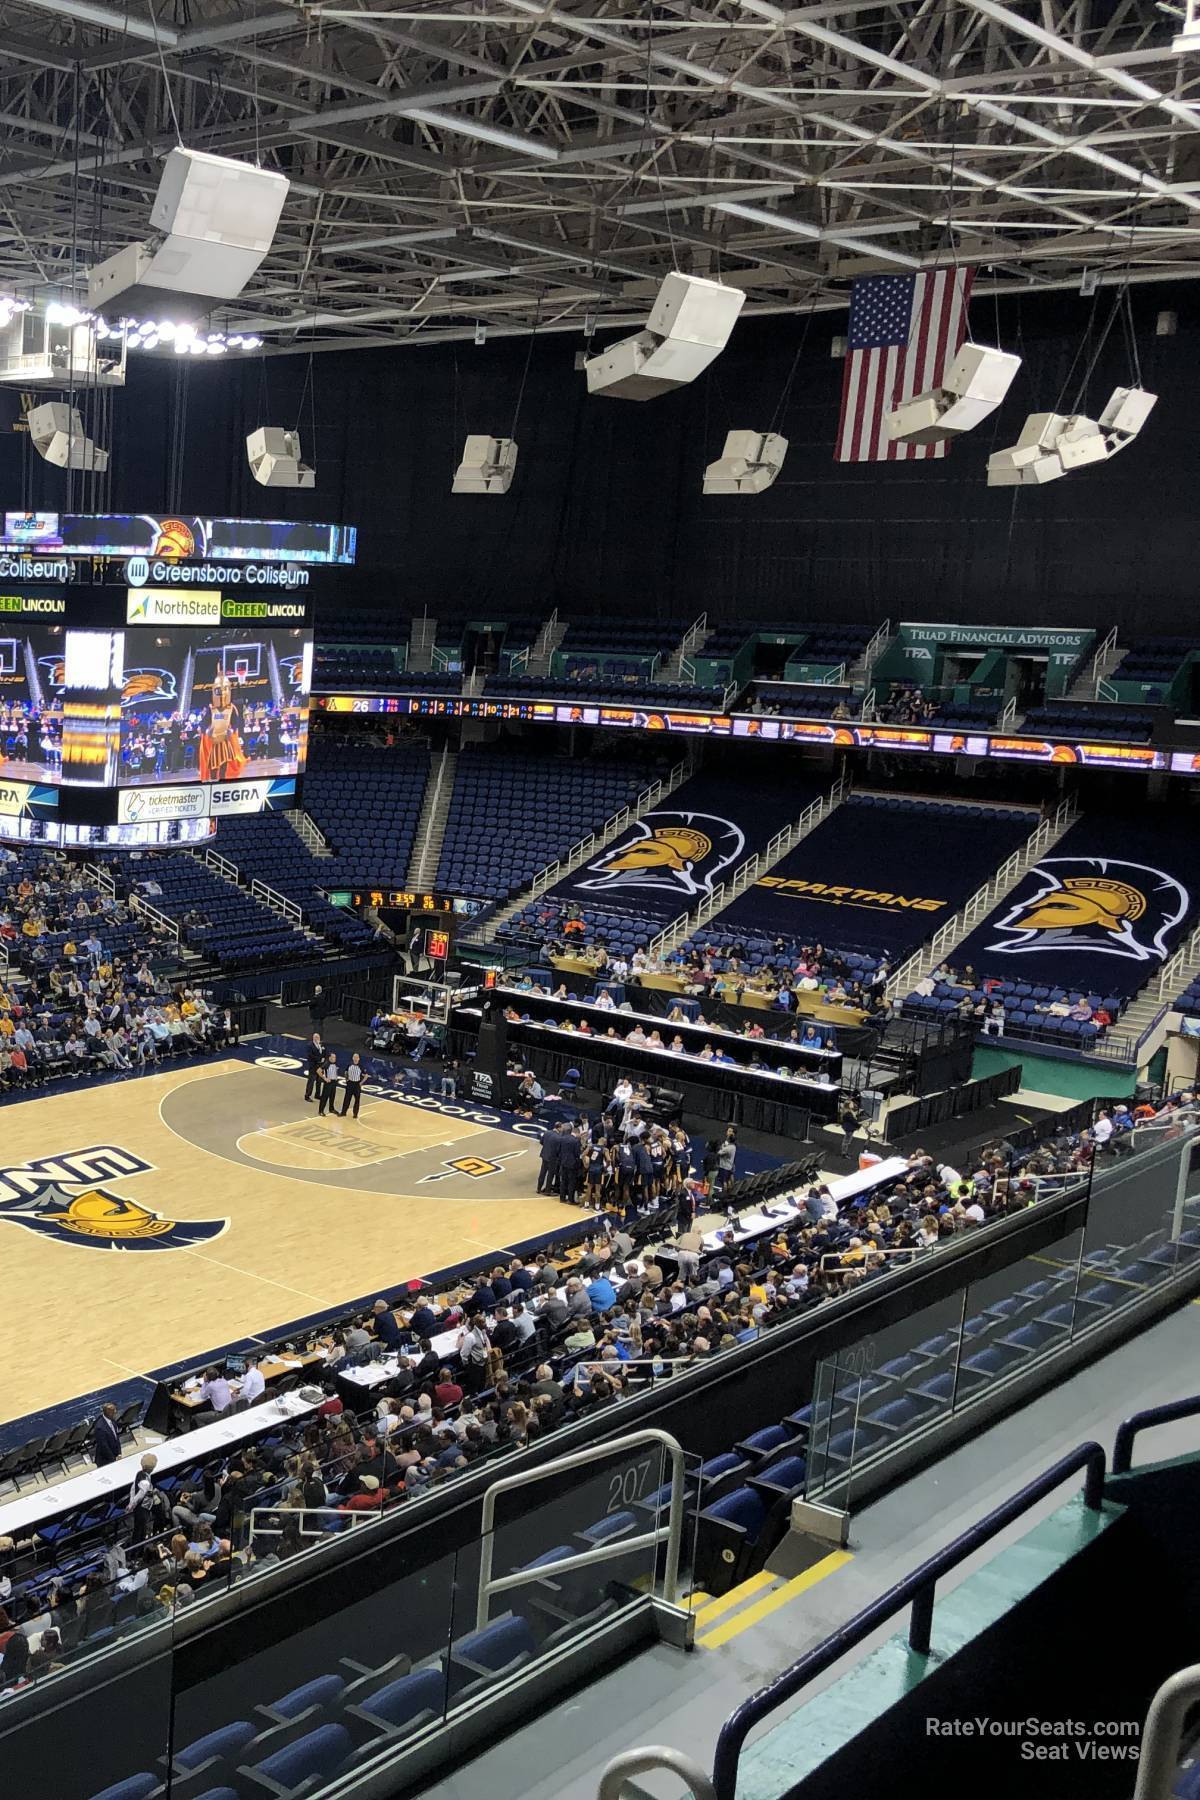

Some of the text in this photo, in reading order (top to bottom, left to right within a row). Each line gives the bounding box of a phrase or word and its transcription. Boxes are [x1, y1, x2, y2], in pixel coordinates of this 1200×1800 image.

[152, 562, 310, 585] Greensboro Coliseum
[155, 600, 219, 616] NorthState
[910, 629, 1081, 646] TRIAD FINANCIAL ADVISORS
[903, 647, 932, 660] TFA
[352, 700, 369, 713] 26
[412, 702, 418, 711] 0
[438, 702, 445, 711] 2
[463, 704, 470, 712] 4
[487, 705, 497, 714] 10
[510, 707, 520, 716] 21
[148, 793, 200, 806] ticketmaster
[212, 788, 259, 804] SEGRA
[174, 804, 197, 812] TICKETS
[396, 894, 415, 903] 3:59
[754, 876, 948, 911] SPARTANS
[355, 896, 361, 905] 3
[371, 897, 383, 906] 27
[423, 901, 434, 909] 26
[433, 932, 447, 942] 3:59
[473, 1071, 493, 1084] TFA
[606, 1459, 651, 1514] 207
